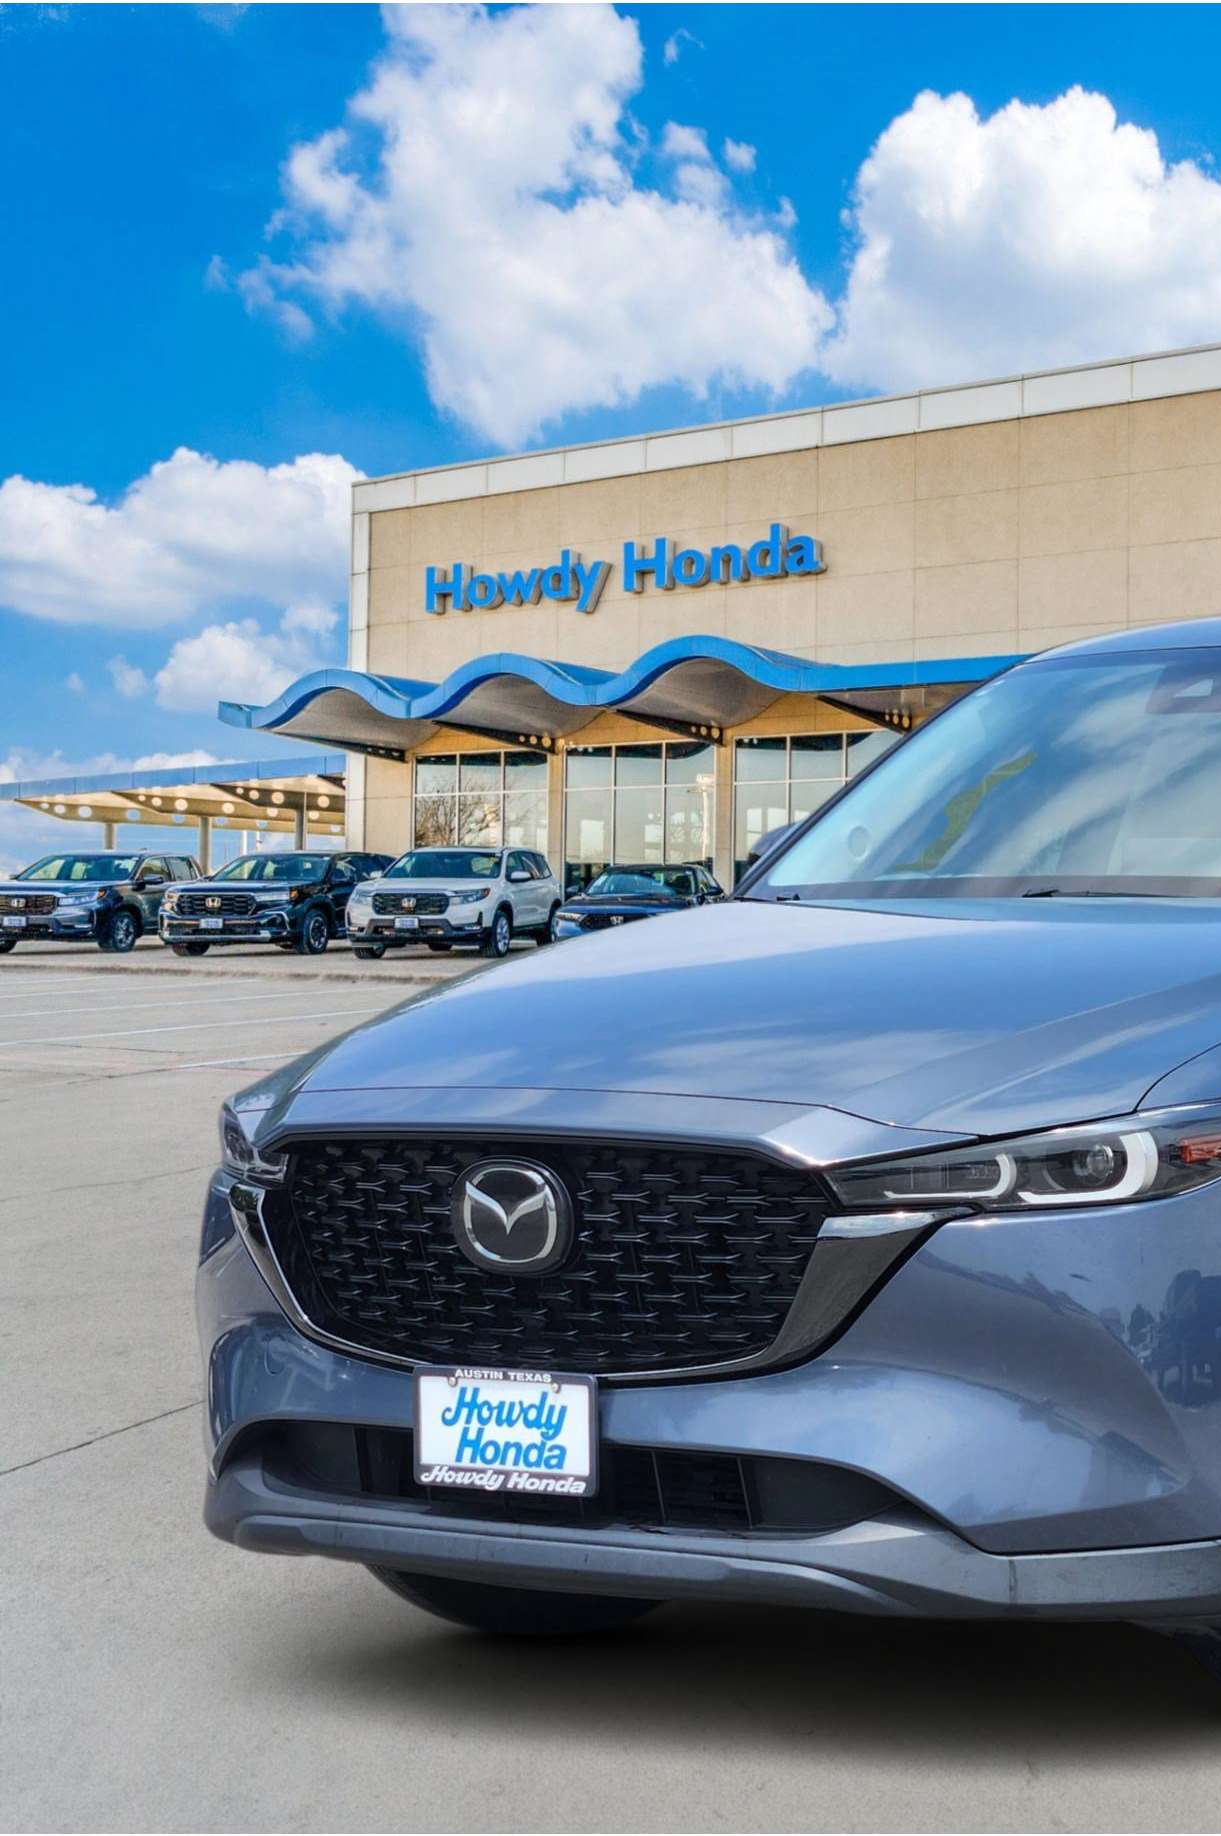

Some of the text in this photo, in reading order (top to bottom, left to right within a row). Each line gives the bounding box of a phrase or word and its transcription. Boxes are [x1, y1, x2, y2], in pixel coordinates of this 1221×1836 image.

[425, 523, 827, 615] Howdy Honda
[455, 1368, 552, 1383] AUSTIN TEXAS
[441, 1386, 568, 1441] Howdy
[455, 1427, 568, 1471] Honda
[420, 1465, 587, 1494] Howdy Honda
